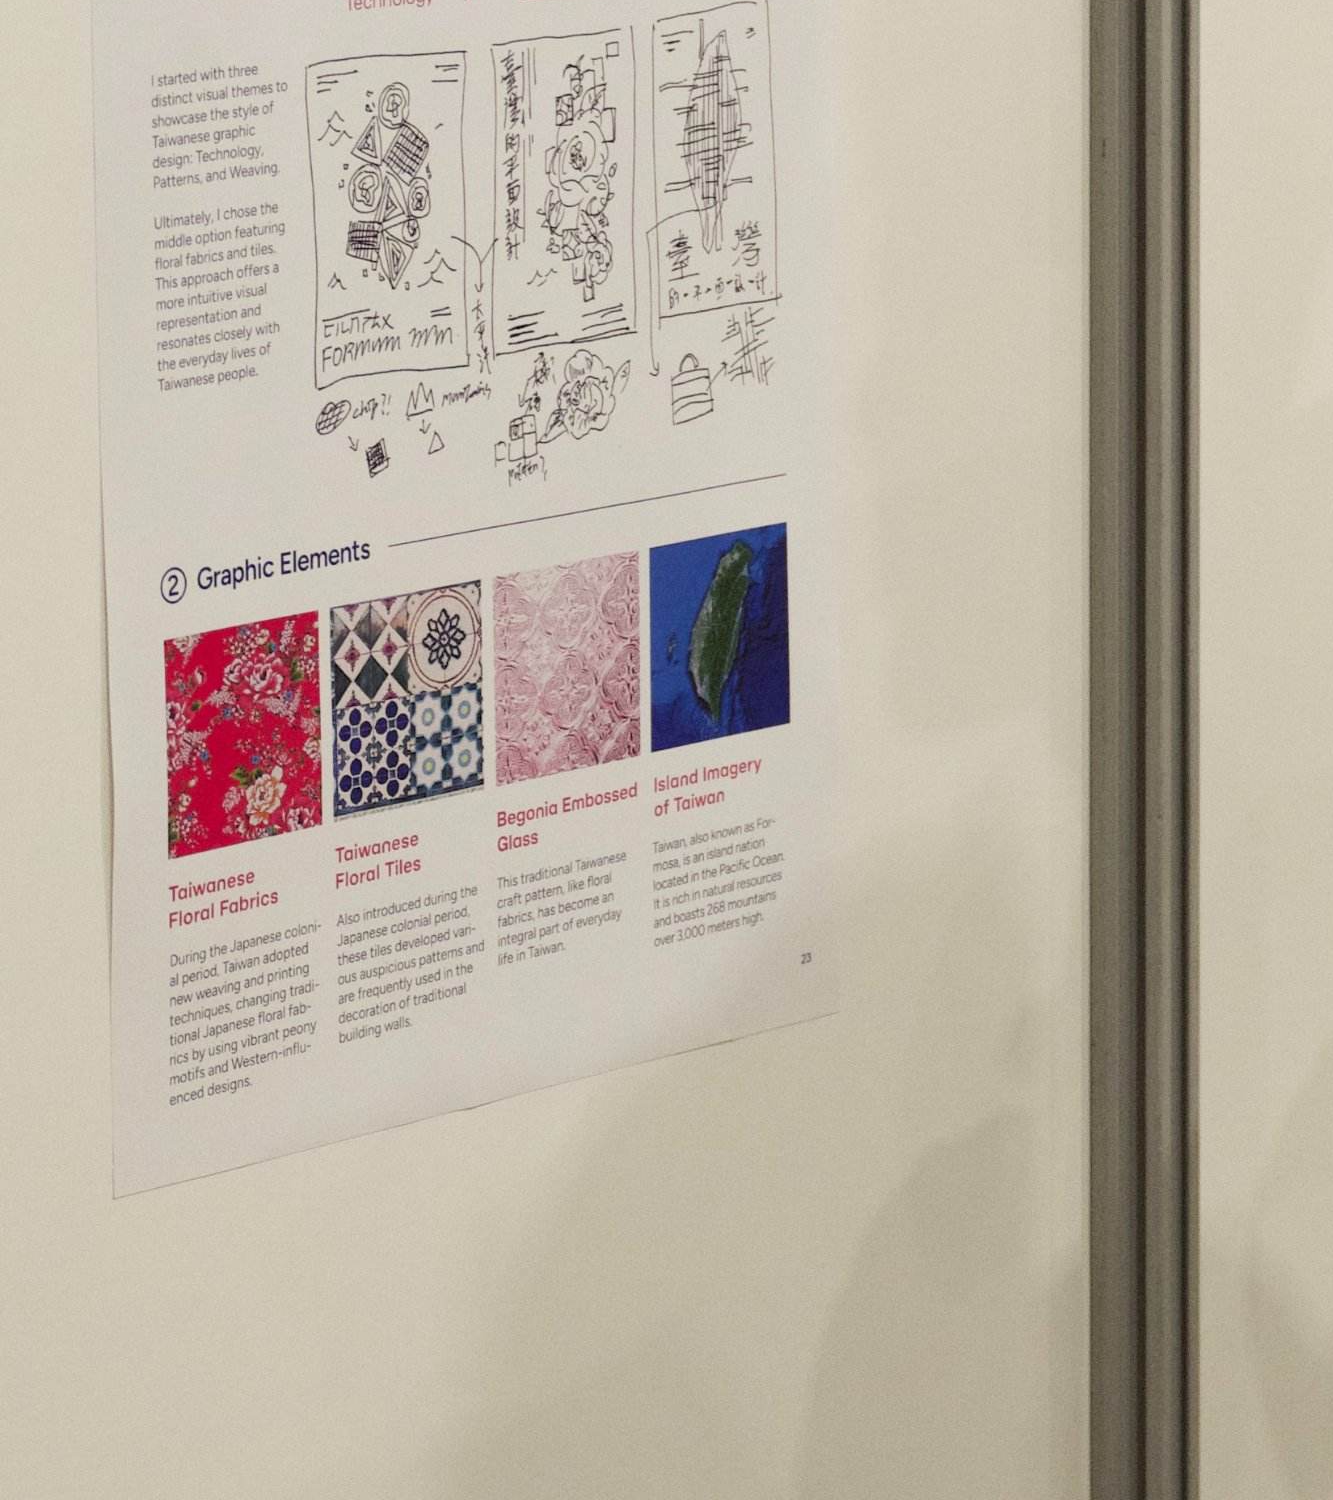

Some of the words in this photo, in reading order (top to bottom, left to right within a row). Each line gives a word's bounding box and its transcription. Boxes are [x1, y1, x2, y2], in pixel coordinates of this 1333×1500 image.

[152, 74, 155, 86] I
[158, 68, 198, 87] started
[200, 66, 226, 81] with
[228, 64, 259, 78] three
[151, 91, 193, 108] distinct
[196, 85, 229, 102] visual
[232, 83, 274, 98] themes
[276, 81, 289, 92] to
[152, 111, 208, 128] showcase
[210, 107, 230, 121] the
[233, 103, 260, 120] style
[262, 99, 275, 115] of
[152, 131, 211, 148] Taiwanese
[213, 124, 256, 144] graphic
[152, 154, 193, 169] design:
[196, 145, 265, 162] Technology,
[153, 173, 203, 188] Patterns,
[206, 167, 227, 182] and
[229, 163, 280, 179] Weaving.
[154, 210, 214, 230] Ultimately,
[217, 208, 221, 220] I
[224, 206, 258, 220] chose
[260, 202, 279, 215] the
[155, 233, 193, 250] middle
[195, 229, 232, 246] option
[235, 222, 286, 238] featuring
[155, 253, 183, 269] floral
[186, 251, 225, 265] fabrics
[227, 245, 248, 260] and
[250, 242, 277, 257] tiles.
[155, 276, 179, 290] This
[181, 267, 234, 289] approach
[237, 263, 270, 279] offers
[273, 263, 280, 273] a
[156, 297, 185, 310] more
[188, 290, 233, 305] intuitive
[236, 282, 268, 299] visual
[157, 309, 238, 332] representation
[241, 303, 262, 319] and
[157, 333, 212, 350] resonates
[214, 325, 253, 342] closely
[256, 321, 281, 335] with
[157, 358, 177, 372] the
[179, 349, 229, 368] everyday
[231, 346, 256, 359] lives
[259, 341, 272, 355] of
[158, 373, 215, 391] Taiwanese
[218, 365, 259, 384] people.
[198, 556, 275, 590] Graphic
[281, 540, 371, 575] Elements
[655, 768, 699, 792] Island
[703, 758, 762, 781] Imagery
[498, 800, 558, 827] Begonia
[563, 781, 638, 813] Embossed
[655, 798, 670, 817] of
[674, 790, 725, 811] Taiwan
[335, 834, 419, 863] Taiwanese
[498, 832, 539, 852] Glass
[336, 864, 380, 889] Floral
[385, 858, 422, 876] Tiles
[497, 876, 519, 889] This
[520, 861, 573, 884] traditional
[575, 851, 627, 871] Taiwanese
[169, 871, 255, 902] Taiwanese
[497, 892, 523, 909] craft
[525, 885, 565, 905] pattern,
[568, 879, 585, 892] like
[587, 872, 612, 887] floral
[169, 902, 215, 928] Floral
[220, 891, 279, 916] Fabrics
[337, 912, 361, 926] Also
[363, 896, 422, 920] introduced
[424, 890, 458, 907] during
[460, 885, 478, 898] the
[337, 925, 388, 946] Japanese
[391, 913, 432, 934] colonial
[435, 905, 471, 926] period,
[170, 949, 207, 967] During
[210, 944, 228, 958] the
[230, 931, 282, 953] Japanese
[284, 923, 322, 939] coloni-
[338, 950, 368, 966] these
[370, 944, 393, 958] tiles
[395, 928, 451, 952] developed
[453, 925, 476, 938] vari-
[170, 972, 180, 987] al
[182, 963, 220, 987] period,
[223, 956, 261, 973] Taiwan
[263, 940, 309, 964] adopted
[170, 993, 194, 1006] new
[196, 980, 241, 1000] weaving
[244, 972, 265, 989] and
[267, 963, 310, 986] printing
[170, 1002, 233, 1027] techniques,
[236, 988, 287, 1010] changing
[290, 980, 320, 997] tradi-
